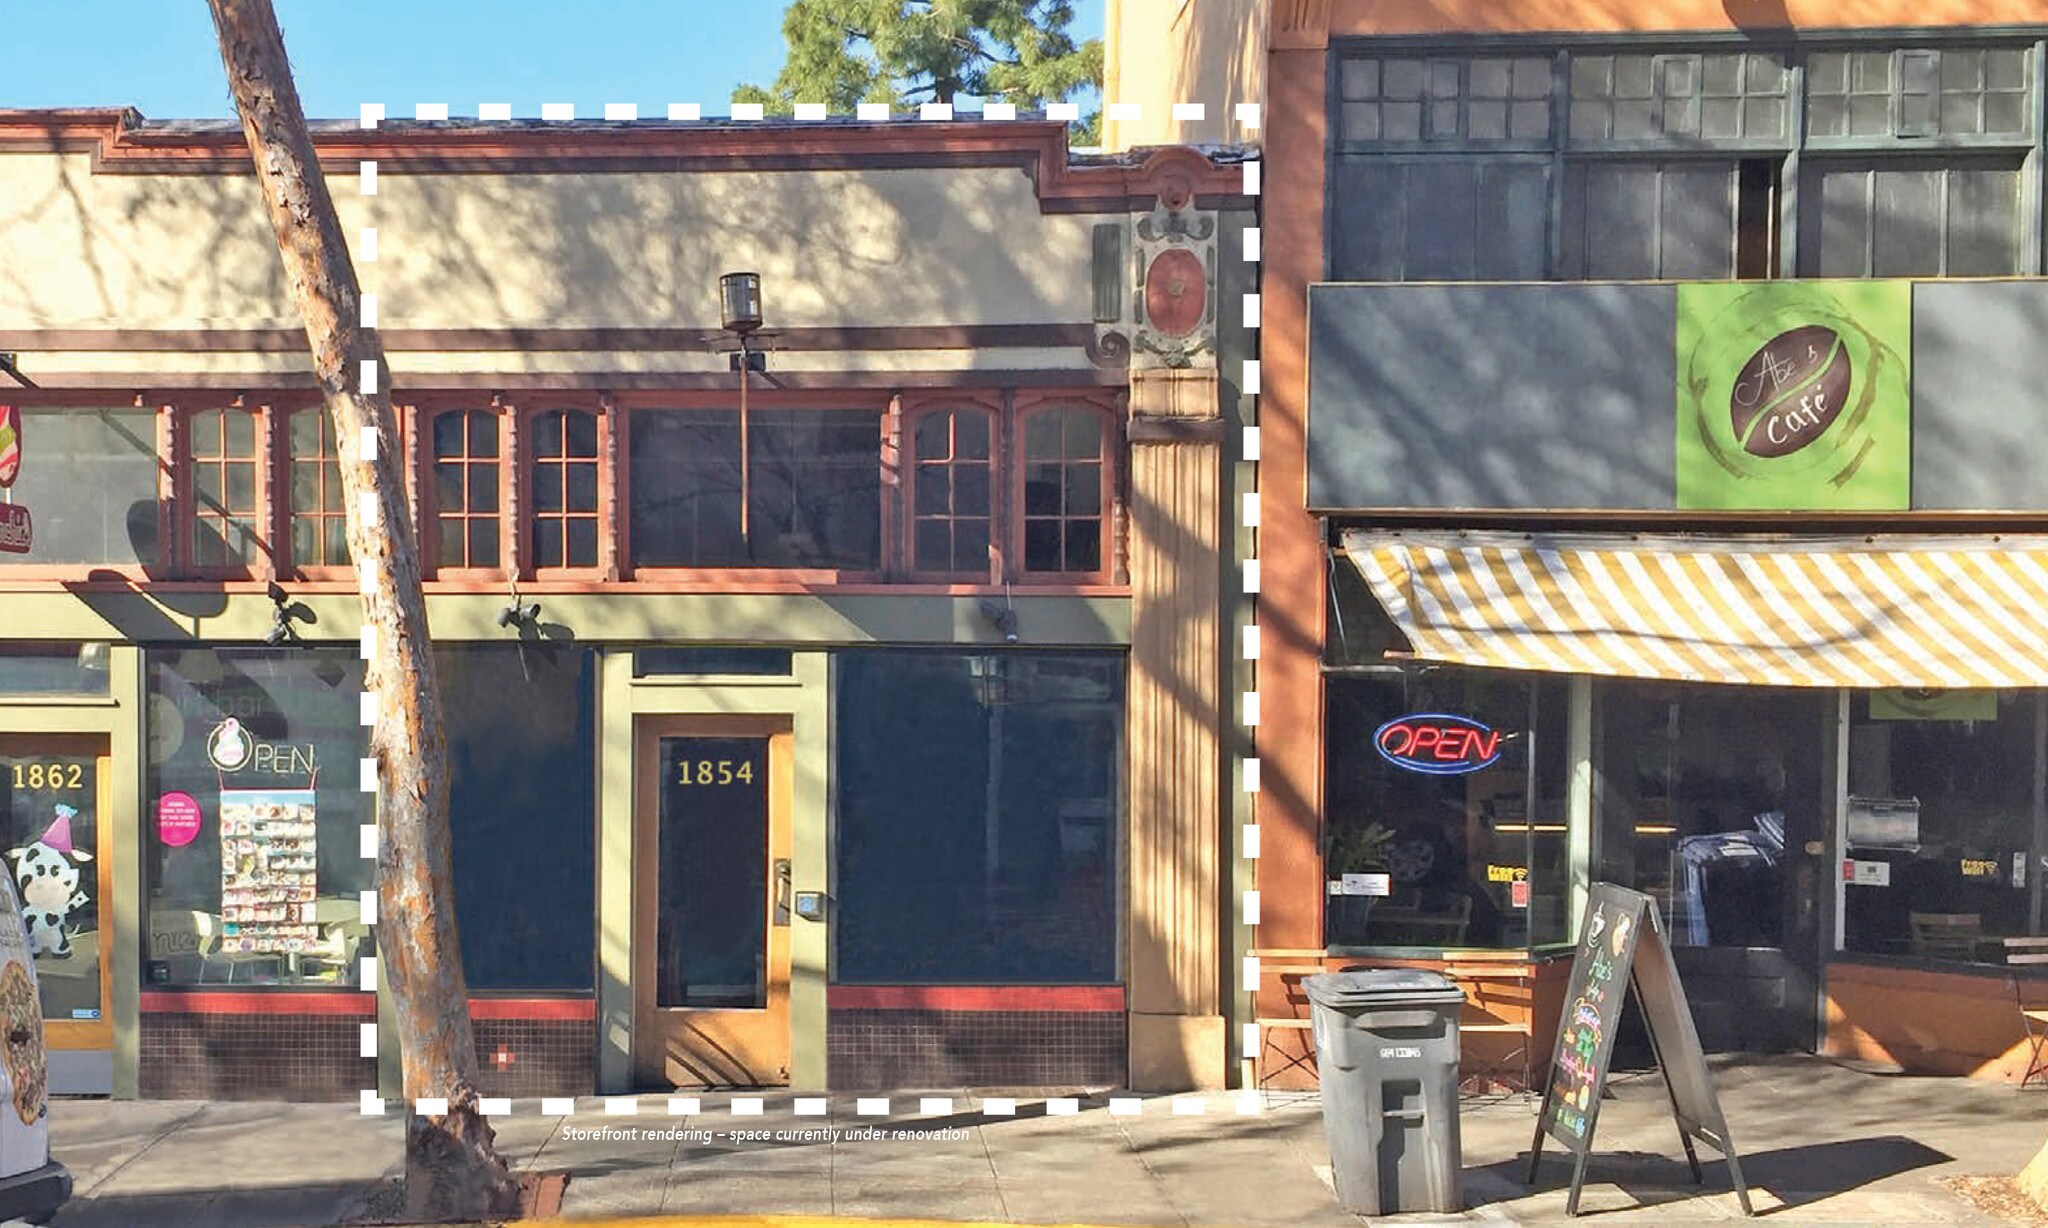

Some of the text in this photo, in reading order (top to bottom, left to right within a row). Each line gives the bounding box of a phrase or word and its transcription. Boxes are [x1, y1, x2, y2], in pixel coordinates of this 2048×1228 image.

[1767, 384, 1828, 444] Café
[207, 719, 315, 773] OPEN
[1381, 724, 1499, 760] OPEN
[12, 764, 84, 789] 1862
[678, 761, 753, 785] 1854
